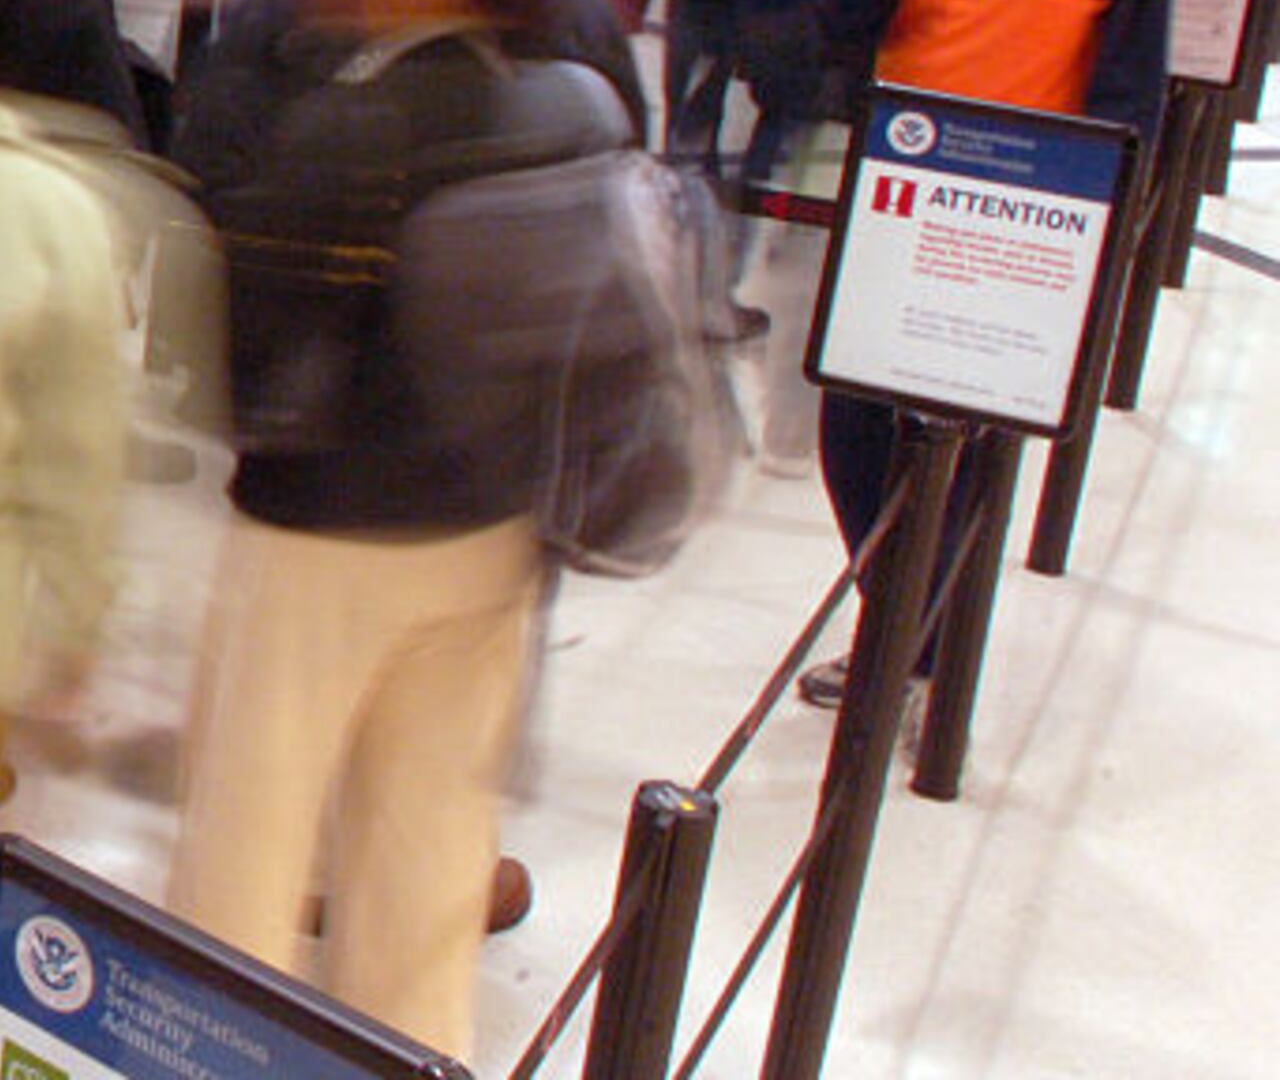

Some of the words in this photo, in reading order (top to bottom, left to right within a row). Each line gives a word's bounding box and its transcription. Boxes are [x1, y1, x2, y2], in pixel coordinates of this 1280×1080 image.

[927, 186, 1088, 235] ATTENTION
[104, 984, 194, 1053] Security
[105, 958, 269, 1066] Transportation
